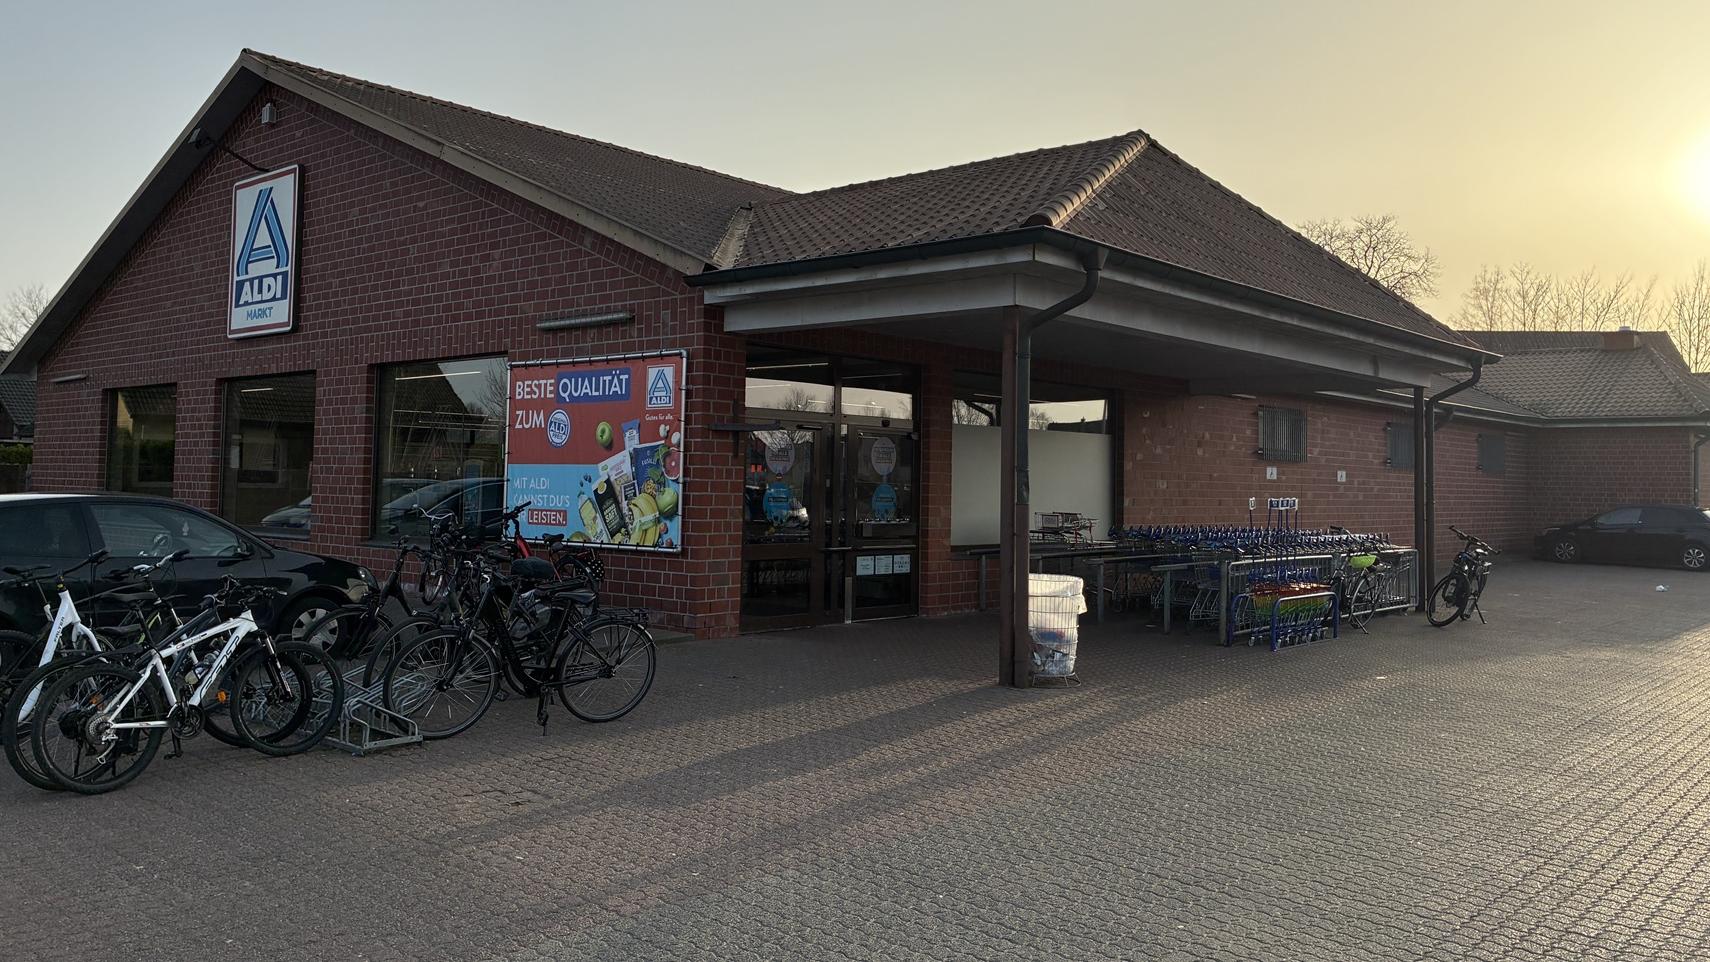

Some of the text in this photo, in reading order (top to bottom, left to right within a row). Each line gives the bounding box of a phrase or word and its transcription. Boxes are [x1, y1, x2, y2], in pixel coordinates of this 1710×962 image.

[239, 275, 282, 305] ALDI
[246, 307, 273, 320] MARKT
[515, 370, 629, 402] BESTE QUALITÄT
[651, 396, 669, 404] ALDI
[515, 409, 545, 429] ZUM
[550, 422, 568, 435] ALDI
[513, 477, 550, 489] MIT ALDI
[549, 495, 570, 507] DU'S
[528, 510, 566, 524] LEISTEN.
